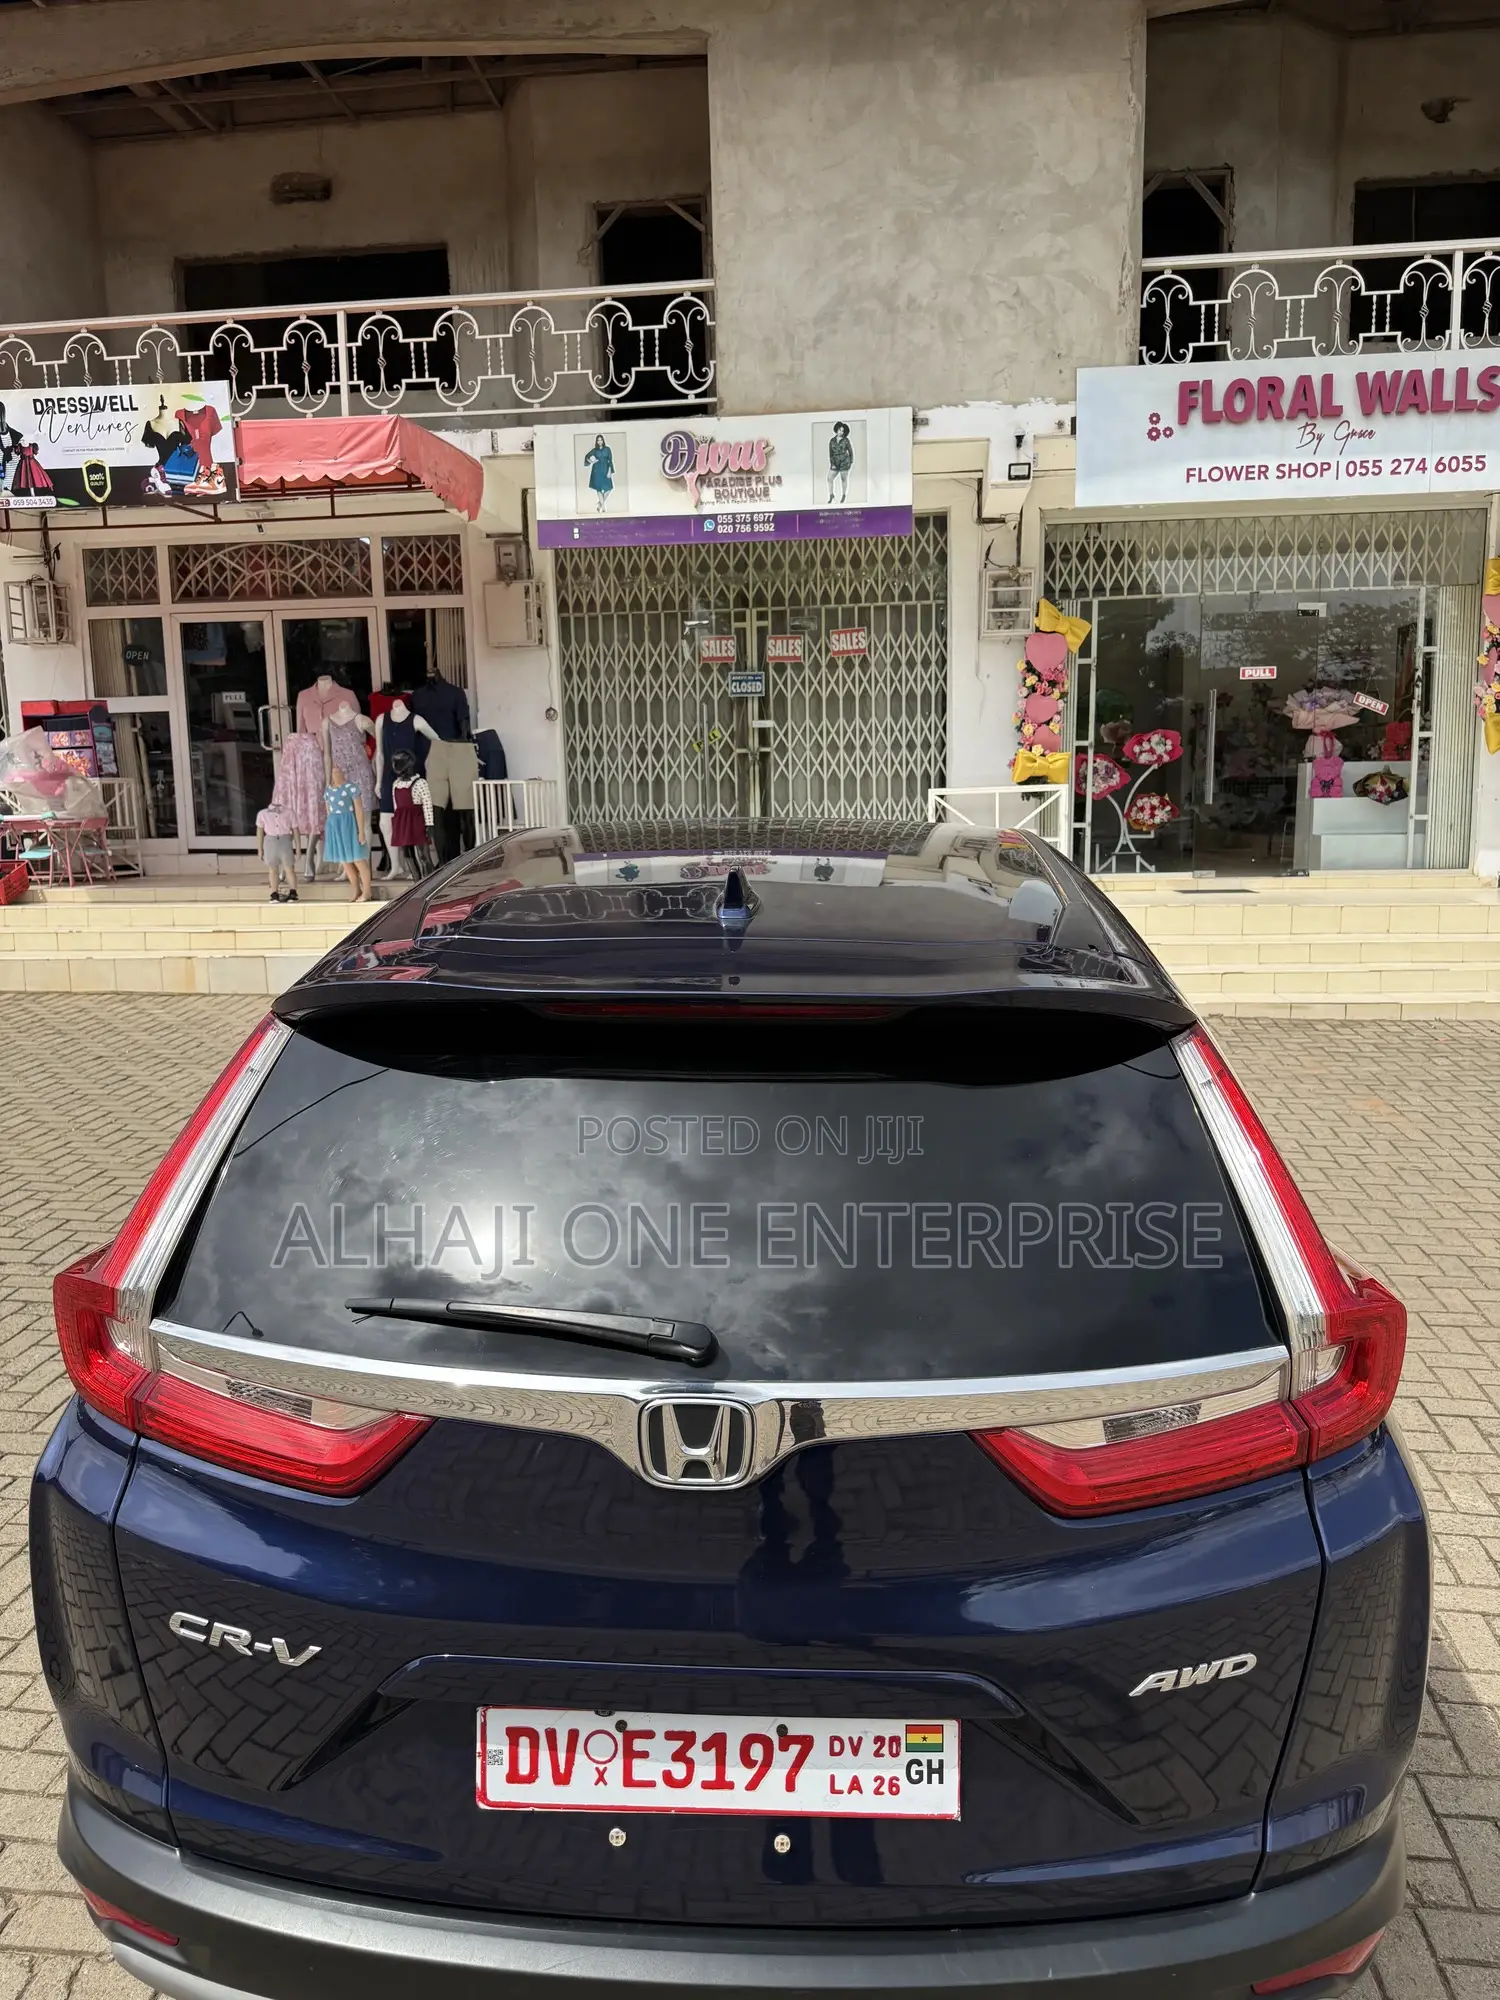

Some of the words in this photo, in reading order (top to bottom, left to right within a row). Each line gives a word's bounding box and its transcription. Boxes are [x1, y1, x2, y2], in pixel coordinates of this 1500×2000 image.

[33, 395, 139, 415] DRESSWELL
[1178, 373, 1344, 425] FLORAL
[1356, 364, 1500, 415] WALLS
[39, 404, 139, 444] Ventures
[1296, 421, 1325, 455] By
[1333, 419, 1377, 455] Grace
[660, 430, 775, 480] Divas
[1186, 463, 1269, 483] FLOWER
[1345, 459, 1383, 479] 055
[1389, 457, 1429, 476] 274
[1434, 455, 1487, 474] 6055
[700, 476, 753, 490] PARADISE
[755, 474, 783, 488] PLUS
[714, 486, 770, 500] BOUTIQUE
[717, 514, 734, 523] 055
[735, 514, 751, 523] 375
[753, 513, 775, 522] 6977
[717, 524, 734, 534] 020
[735, 524, 752, 533] 756
[754, 522, 775, 532] 9592
[701, 639, 735, 658] SALES
[768, 639, 803, 658] SALES
[831, 631, 867, 652] SALES
[126, 650, 149, 661] OPEN
[1244, 668, 1272, 678] PULL
[731, 681, 762, 693] CLOSED
[1357, 696, 1383, 712] OPEN
[169, 1611, 322, 1667] CR-V
[1129, 1652, 1257, 1697] AWD
[829, 1735, 864, 1758] DV
[872, 1735, 902, 1759] 20
[505, 1726, 580, 1786] DV
[622, 1729, 815, 1793] E3197
[905, 1759, 945, 1786] GH
[829, 1773, 864, 1796] LA
[872, 1774, 902, 1796] 26
